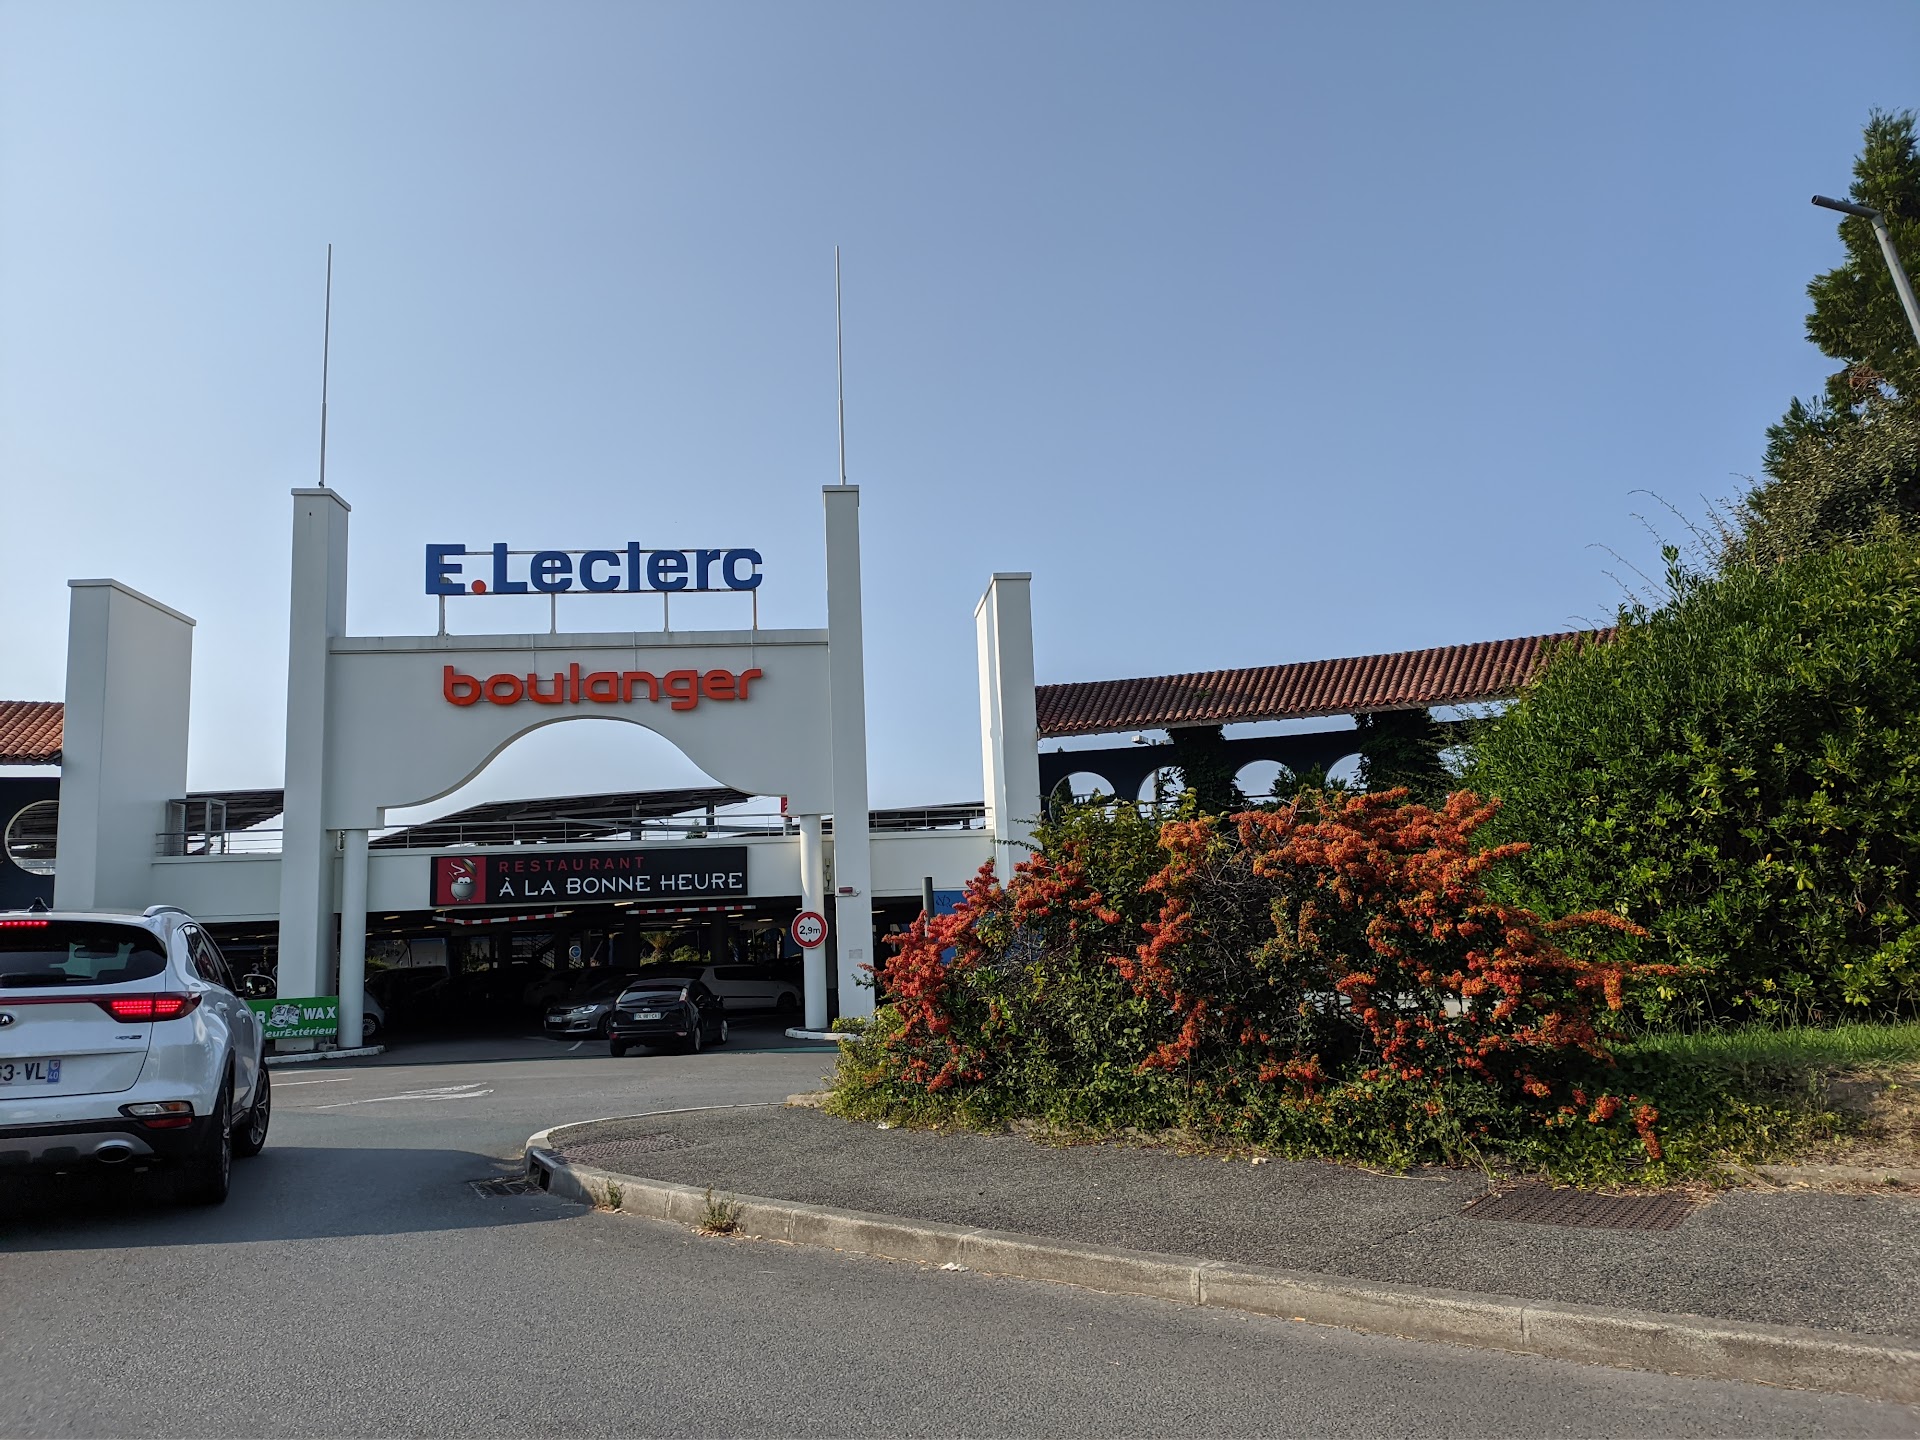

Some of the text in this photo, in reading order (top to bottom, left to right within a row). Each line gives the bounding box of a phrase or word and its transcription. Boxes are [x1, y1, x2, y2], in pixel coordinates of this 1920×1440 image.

[426, 542, 763, 595] E.Leclerc
[443, 662, 762, 710] boulanger
[499, 856, 645, 873] RESTAURANT
[499, 872, 743, 897] À LA BONNE HEURE
[799, 925, 821, 936] 2,9m
[303, 1006, 336, 1020] WAX
